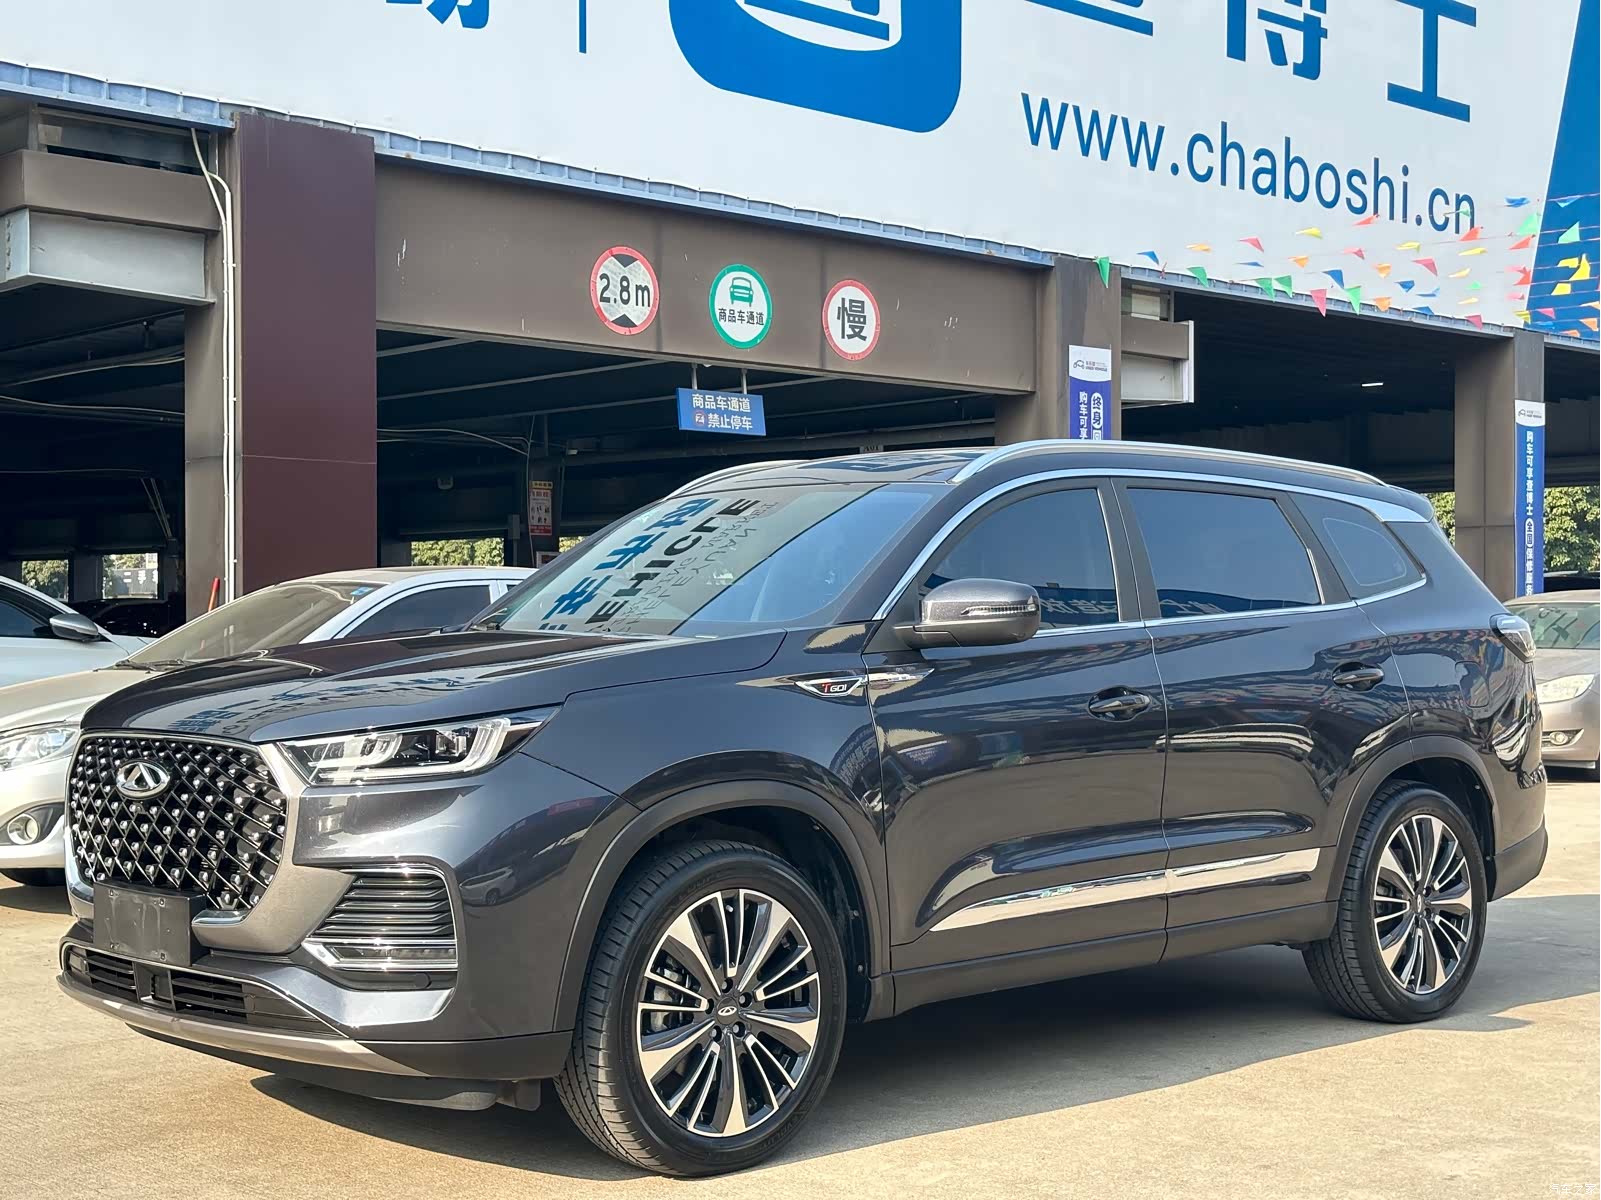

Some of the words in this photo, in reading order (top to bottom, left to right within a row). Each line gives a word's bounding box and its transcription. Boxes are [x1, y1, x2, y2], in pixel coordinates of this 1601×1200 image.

[1021, 92, 1476, 234] www.chaboshi.cn
[717, 307, 766, 326] 商品车通道
[836, 297, 868, 342] 慢
[691, 393, 751, 413] 商品车通道
[708, 412, 753, 431] 禁止停车
